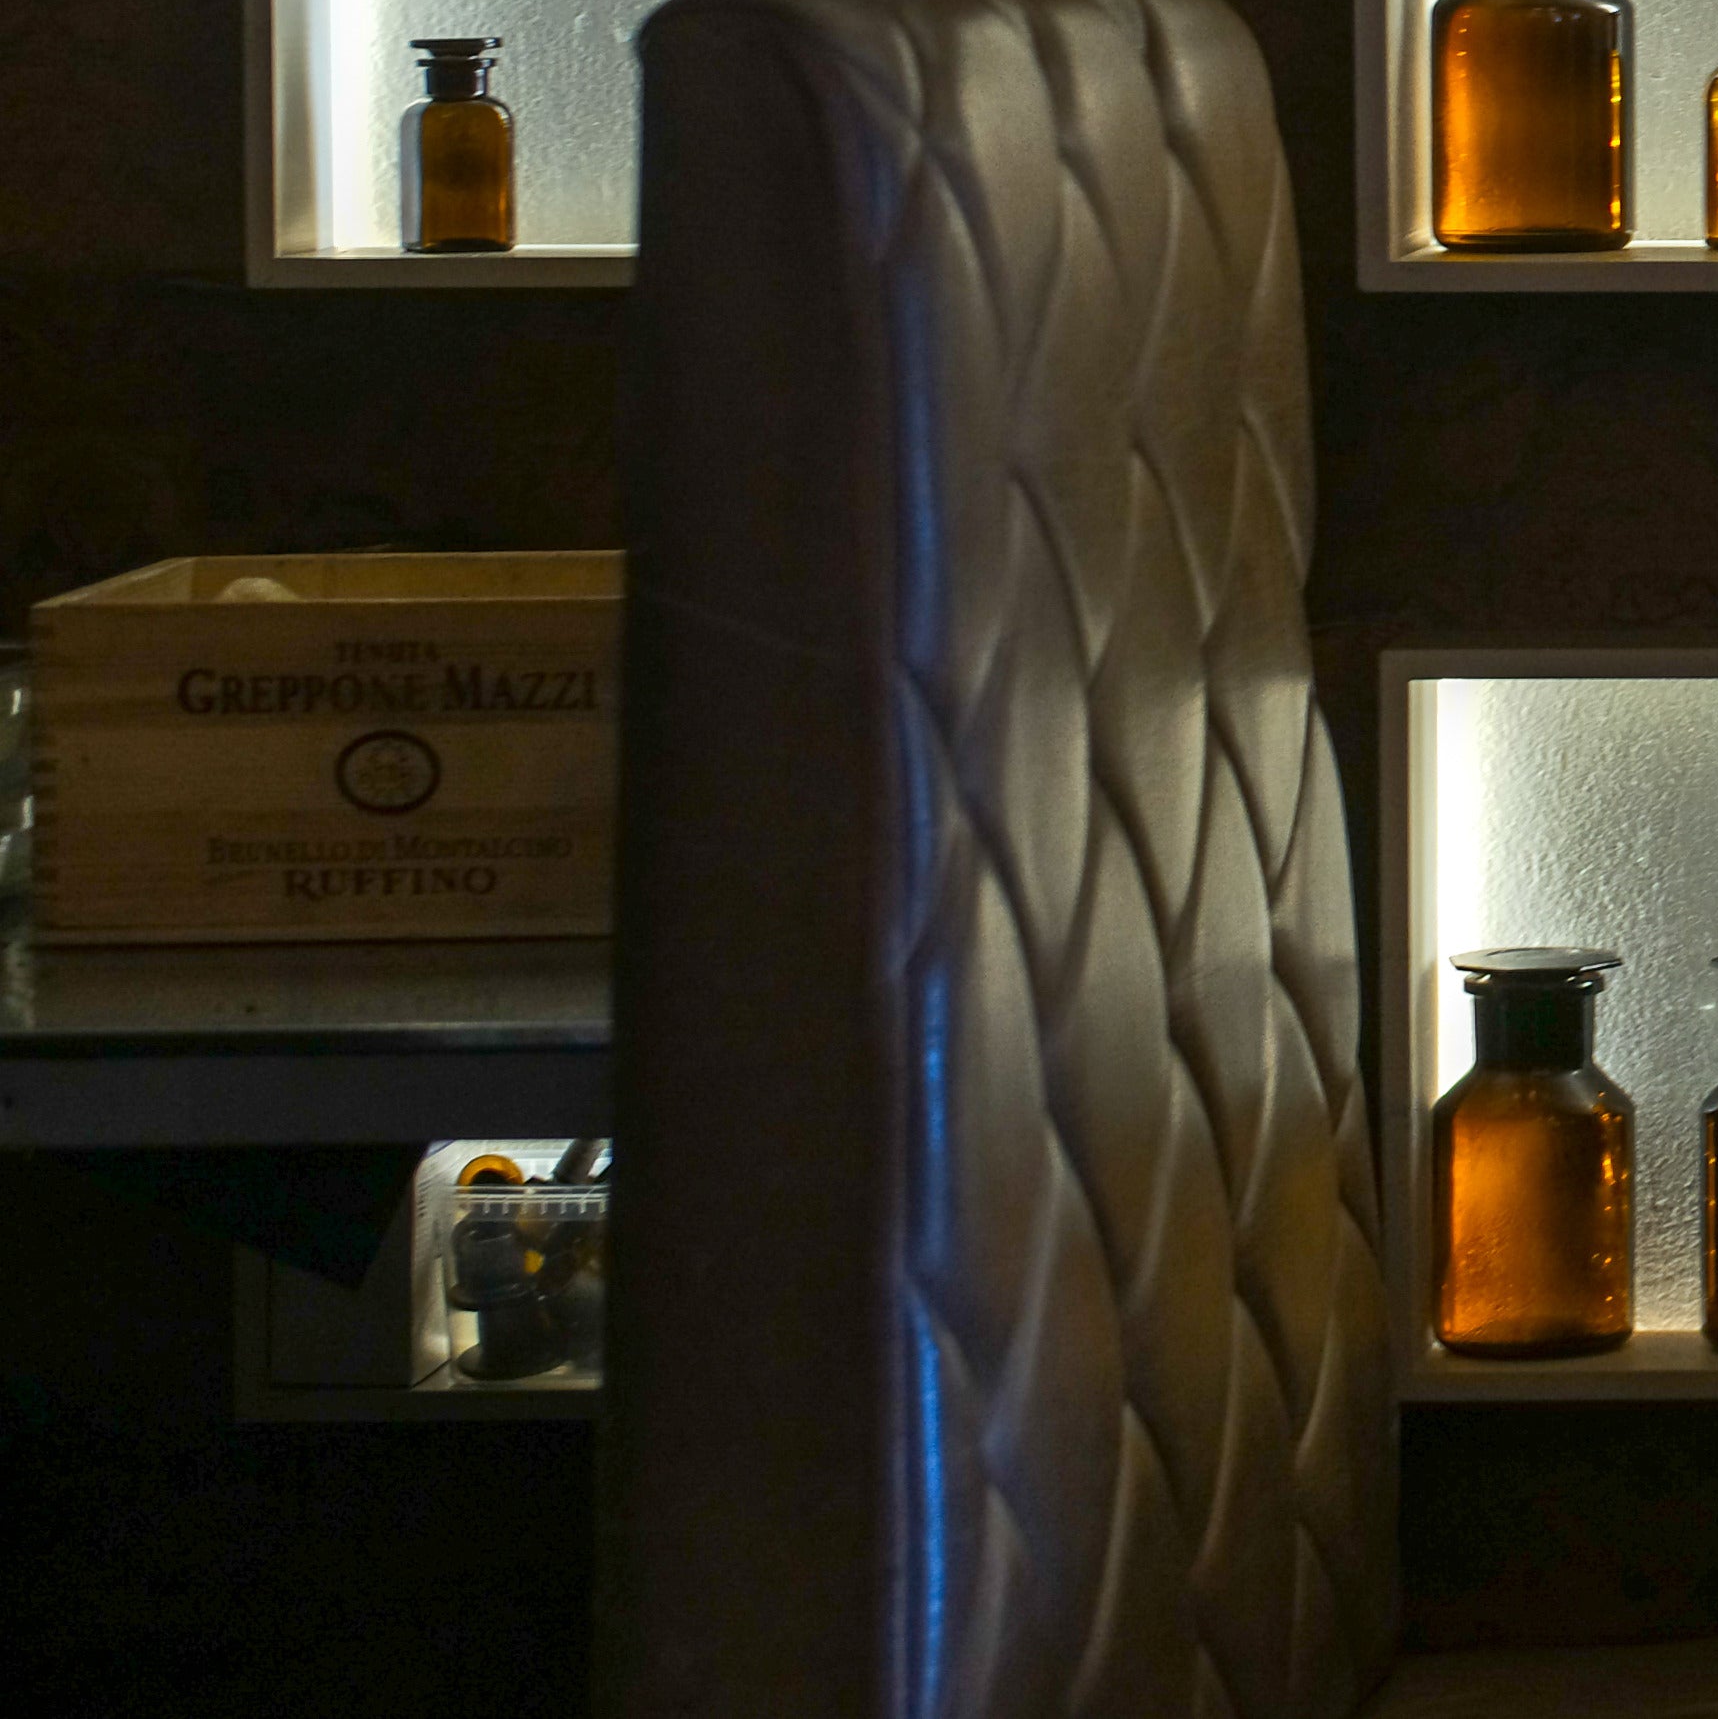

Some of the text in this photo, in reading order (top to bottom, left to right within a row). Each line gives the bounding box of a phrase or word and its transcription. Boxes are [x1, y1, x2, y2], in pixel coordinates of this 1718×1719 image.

[176, 663, 598, 715] GREPPONE MAZZI
[283, 866, 498, 902] RUFFINO
